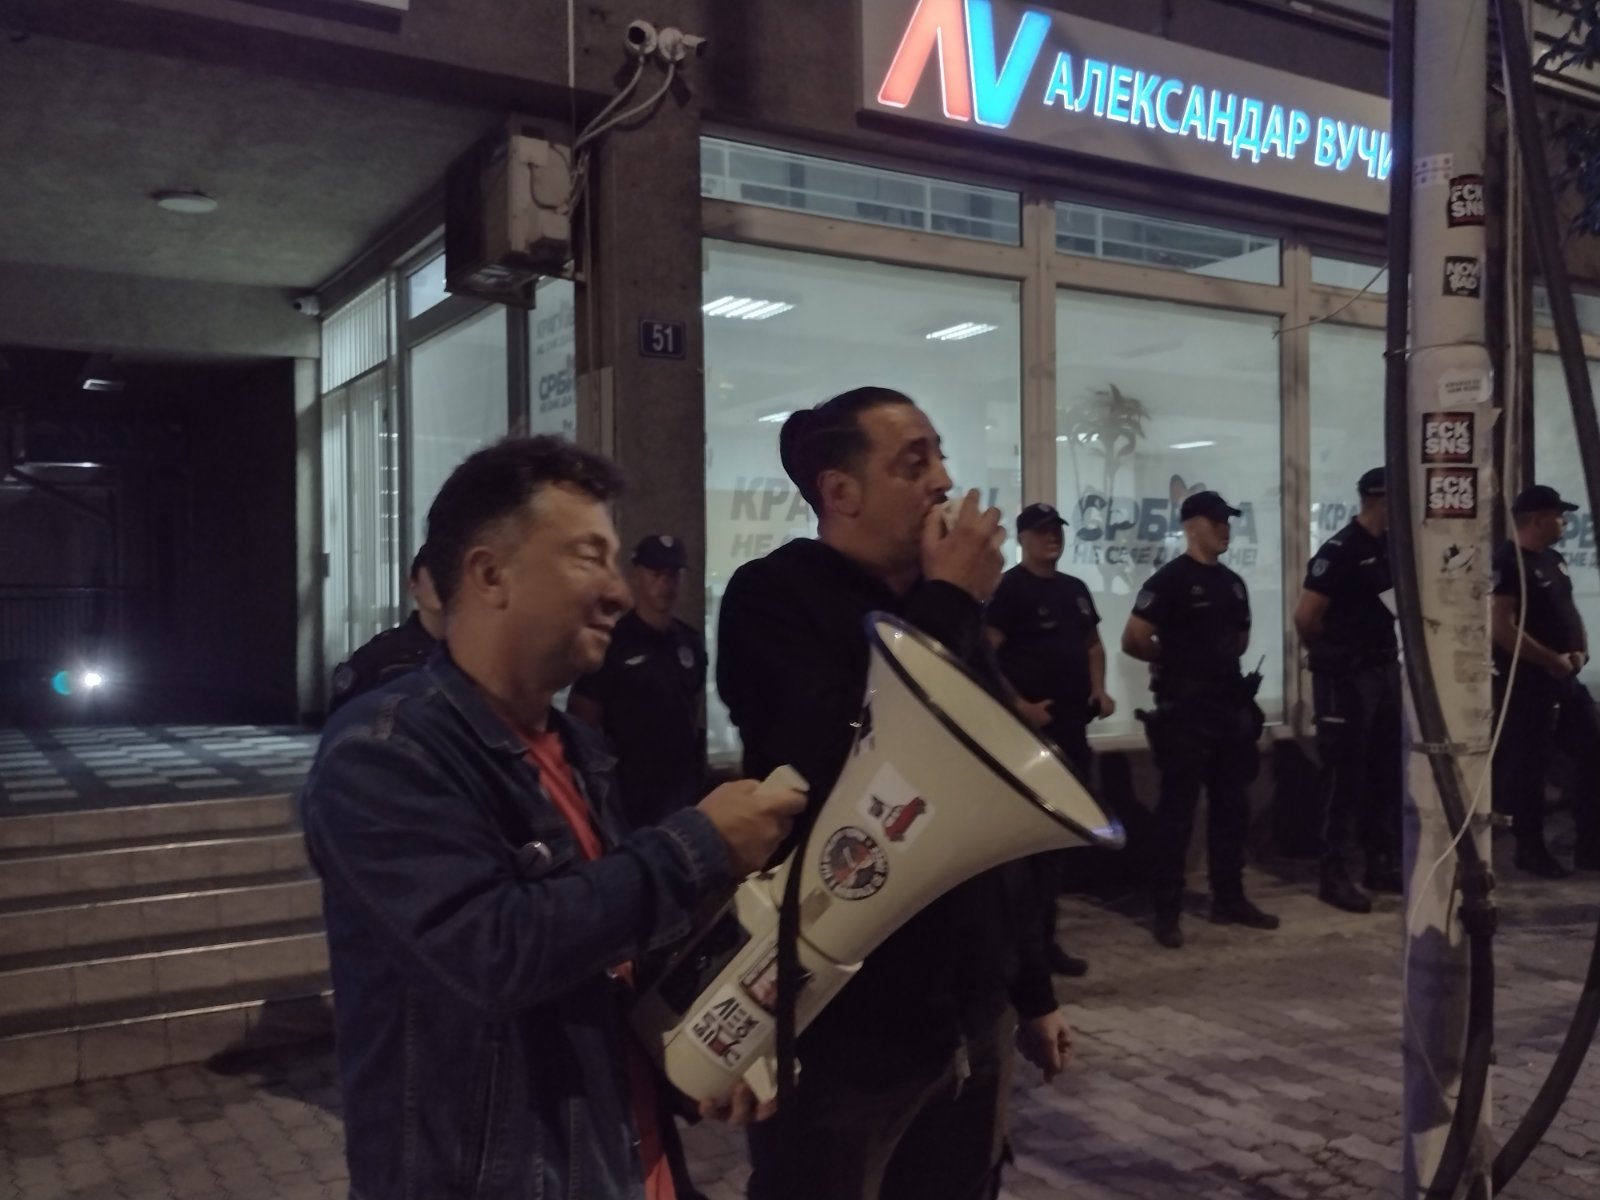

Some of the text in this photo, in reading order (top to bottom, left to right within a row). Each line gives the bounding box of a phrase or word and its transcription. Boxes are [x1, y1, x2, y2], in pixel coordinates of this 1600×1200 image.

[1043, 52, 1393, 181] АЛЕКСАНДАР ВУЧИ
[652, 323, 674, 352] 51
[1425, 420, 1470, 439] FCK
[1424, 438, 1471, 455] SNS
[1430, 476, 1473, 495] FCK
[1429, 493, 1475, 510] SNS
